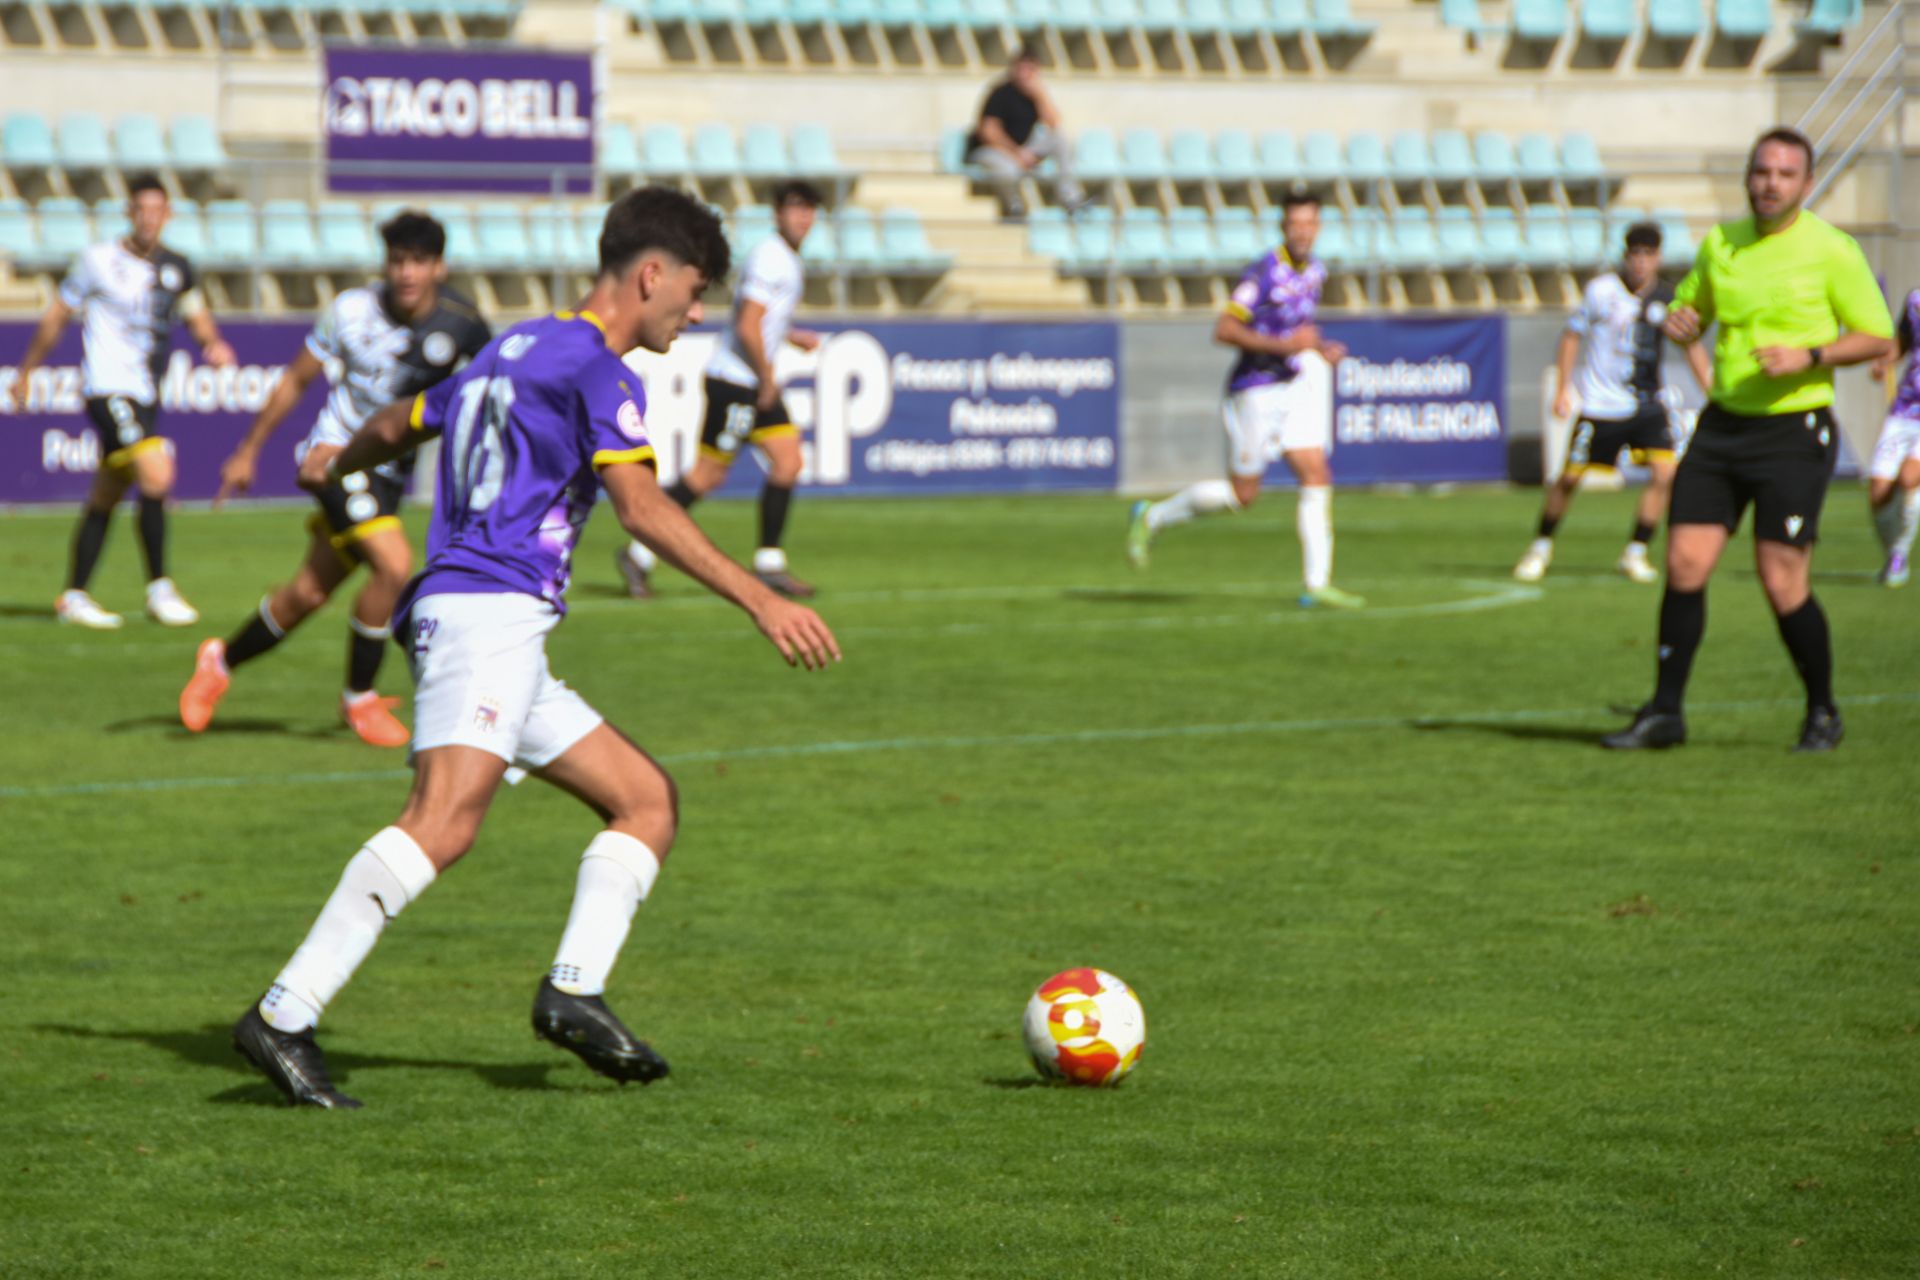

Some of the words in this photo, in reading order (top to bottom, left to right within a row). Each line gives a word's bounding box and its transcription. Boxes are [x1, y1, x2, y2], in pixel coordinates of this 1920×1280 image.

[364, 78, 480, 137] TACO
[480, 79, 590, 138] BELL
[1338, 356, 1470, 399] Diputación
[1338, 403, 1376, 442] DE
[1378, 401, 1500, 441] PALENCIA
